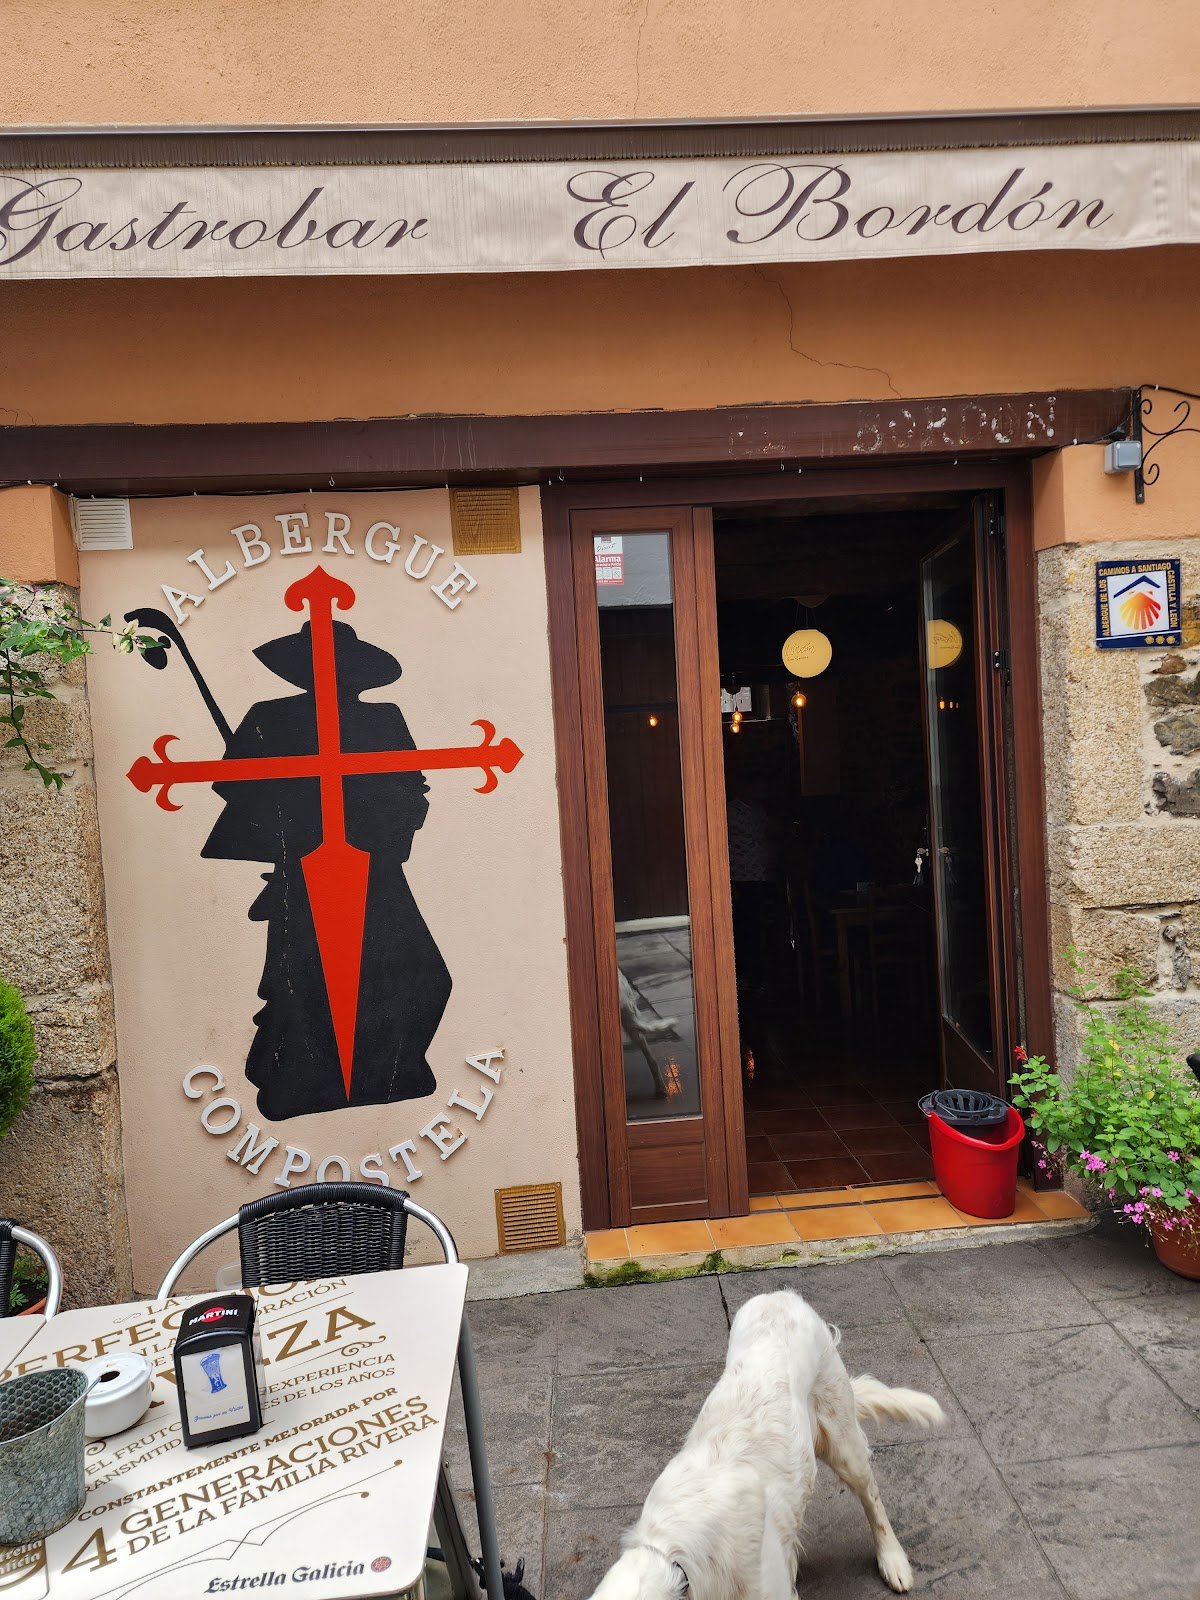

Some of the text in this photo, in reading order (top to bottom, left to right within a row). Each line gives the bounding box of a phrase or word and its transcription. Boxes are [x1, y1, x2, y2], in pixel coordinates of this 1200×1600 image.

[0, 162, 1115, 266] Gastrobar El Bordón
[160, 511, 478, 625] ALBERGUE
[1099, 562, 1171, 576] CAMINOS A SANTIAGO
[1099, 579, 1110, 636] ALBERGUE DE LOS
[1167, 570, 1176, 602] CASTILLA
[182, 1047, 505, 1187] COMPOSTELA
[146, 1298, 180, 1315] LA
[188, 1308, 238, 1326] MARTINI
[78, 1387, 398, 1522] CONSTANTEMENTE MEJORADA POR
[84, 1438, 182, 1492] RANSMITID
[284, 1389, 307, 1402] DE
[311, 1378, 343, 1395] LOS
[348, 1367, 395, 1385] AÑOS
[85, 1459, 112, 1476] EL
[269, 1353, 396, 1394] EXPERIENCIA
[61, 1395, 428, 1575] 4 GENERACIONES
[127, 1414, 439, 1556] DE LA FAMILIA RIVERA
[203, 1570, 287, 1594] Estrella
[292, 1560, 365, 1584] Galicia
